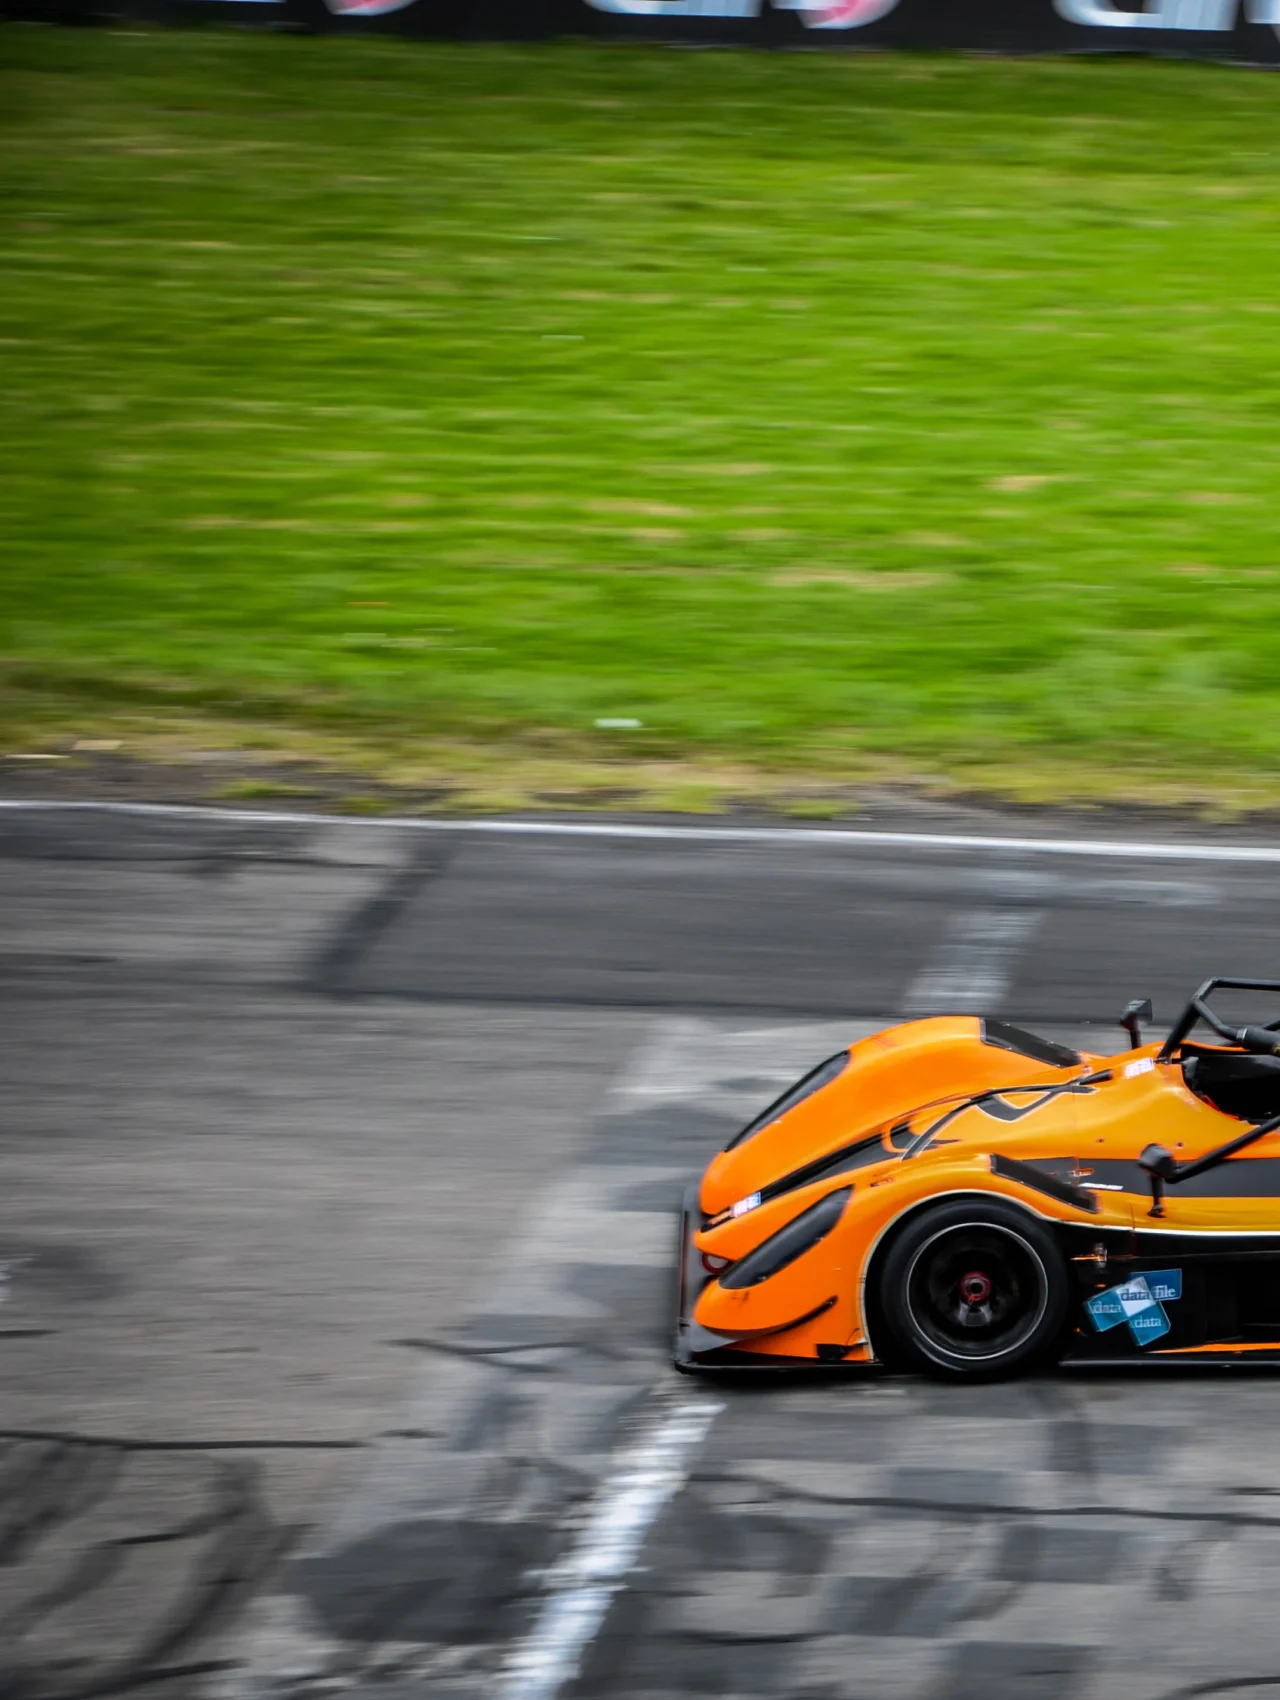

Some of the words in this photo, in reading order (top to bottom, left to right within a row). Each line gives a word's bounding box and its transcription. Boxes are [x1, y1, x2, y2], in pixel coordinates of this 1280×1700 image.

[1120, 1288, 1151, 1301] data
[1154, 1284, 1176, 1299] file
[1093, 1301, 1121, 1314] data
[1134, 1316, 1162, 1328] data
